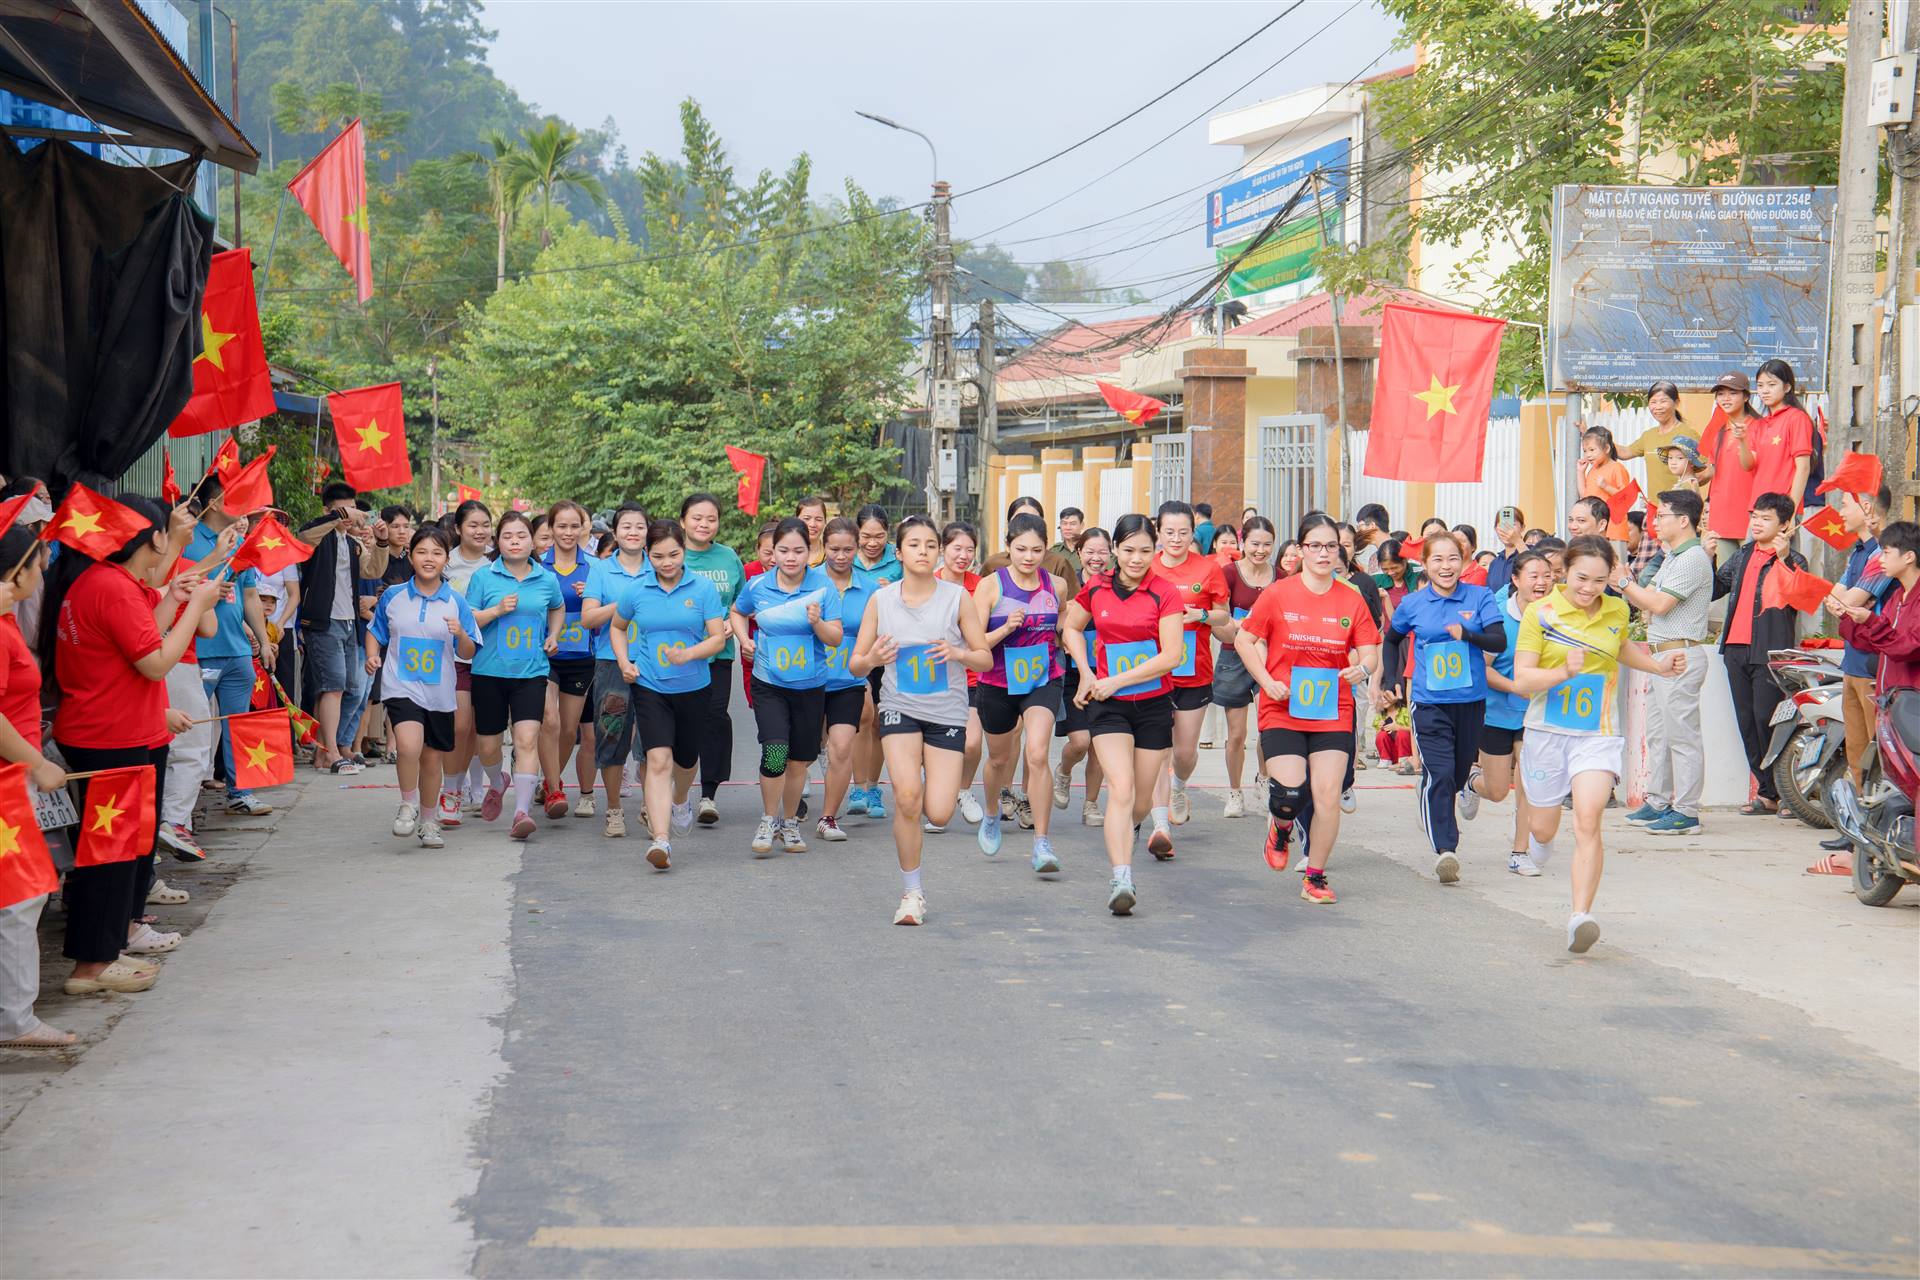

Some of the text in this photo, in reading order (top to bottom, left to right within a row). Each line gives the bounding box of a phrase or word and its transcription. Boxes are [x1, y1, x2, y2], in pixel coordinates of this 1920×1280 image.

[1588, 189, 1612, 206] MẶT
[1615, 188, 1637, 205] CẮT
[1639, 192, 1680, 205] NGANG
[1682, 189, 1711, 205] TUYẾ
[1722, 190, 1764, 206] ĐƯỜNG
[1584, 208, 1606, 220] PHẠM
[1607, 209, 1615, 218] VI
[1617, 206, 1633, 219] BẢO
[1635, 207, 1645, 221] VỆ
[1647, 206, 1661, 219] KẾT
[1663, 207, 1680, 219] CẤU
[1718, 210, 1737, 220] GIAO
[1740, 208, 1767, 220] THÔNG
[1769, 208, 1798, 220] ĐƯỜNG
[1800, 208, 1813, 221] BỘ
[505, 626, 532, 649] 01
[1288, 633, 1321, 643] FINISHER
[405, 647, 436, 673] 36
[775, 646, 807, 672] 04
[824, 646, 849, 669] 21
[907, 655, 936, 683] 11
[1013, 655, 1045, 683] 05
[1432, 652, 1463, 679] 09
[1298, 679, 1331, 706] 07
[1558, 686, 1593, 718] 16
